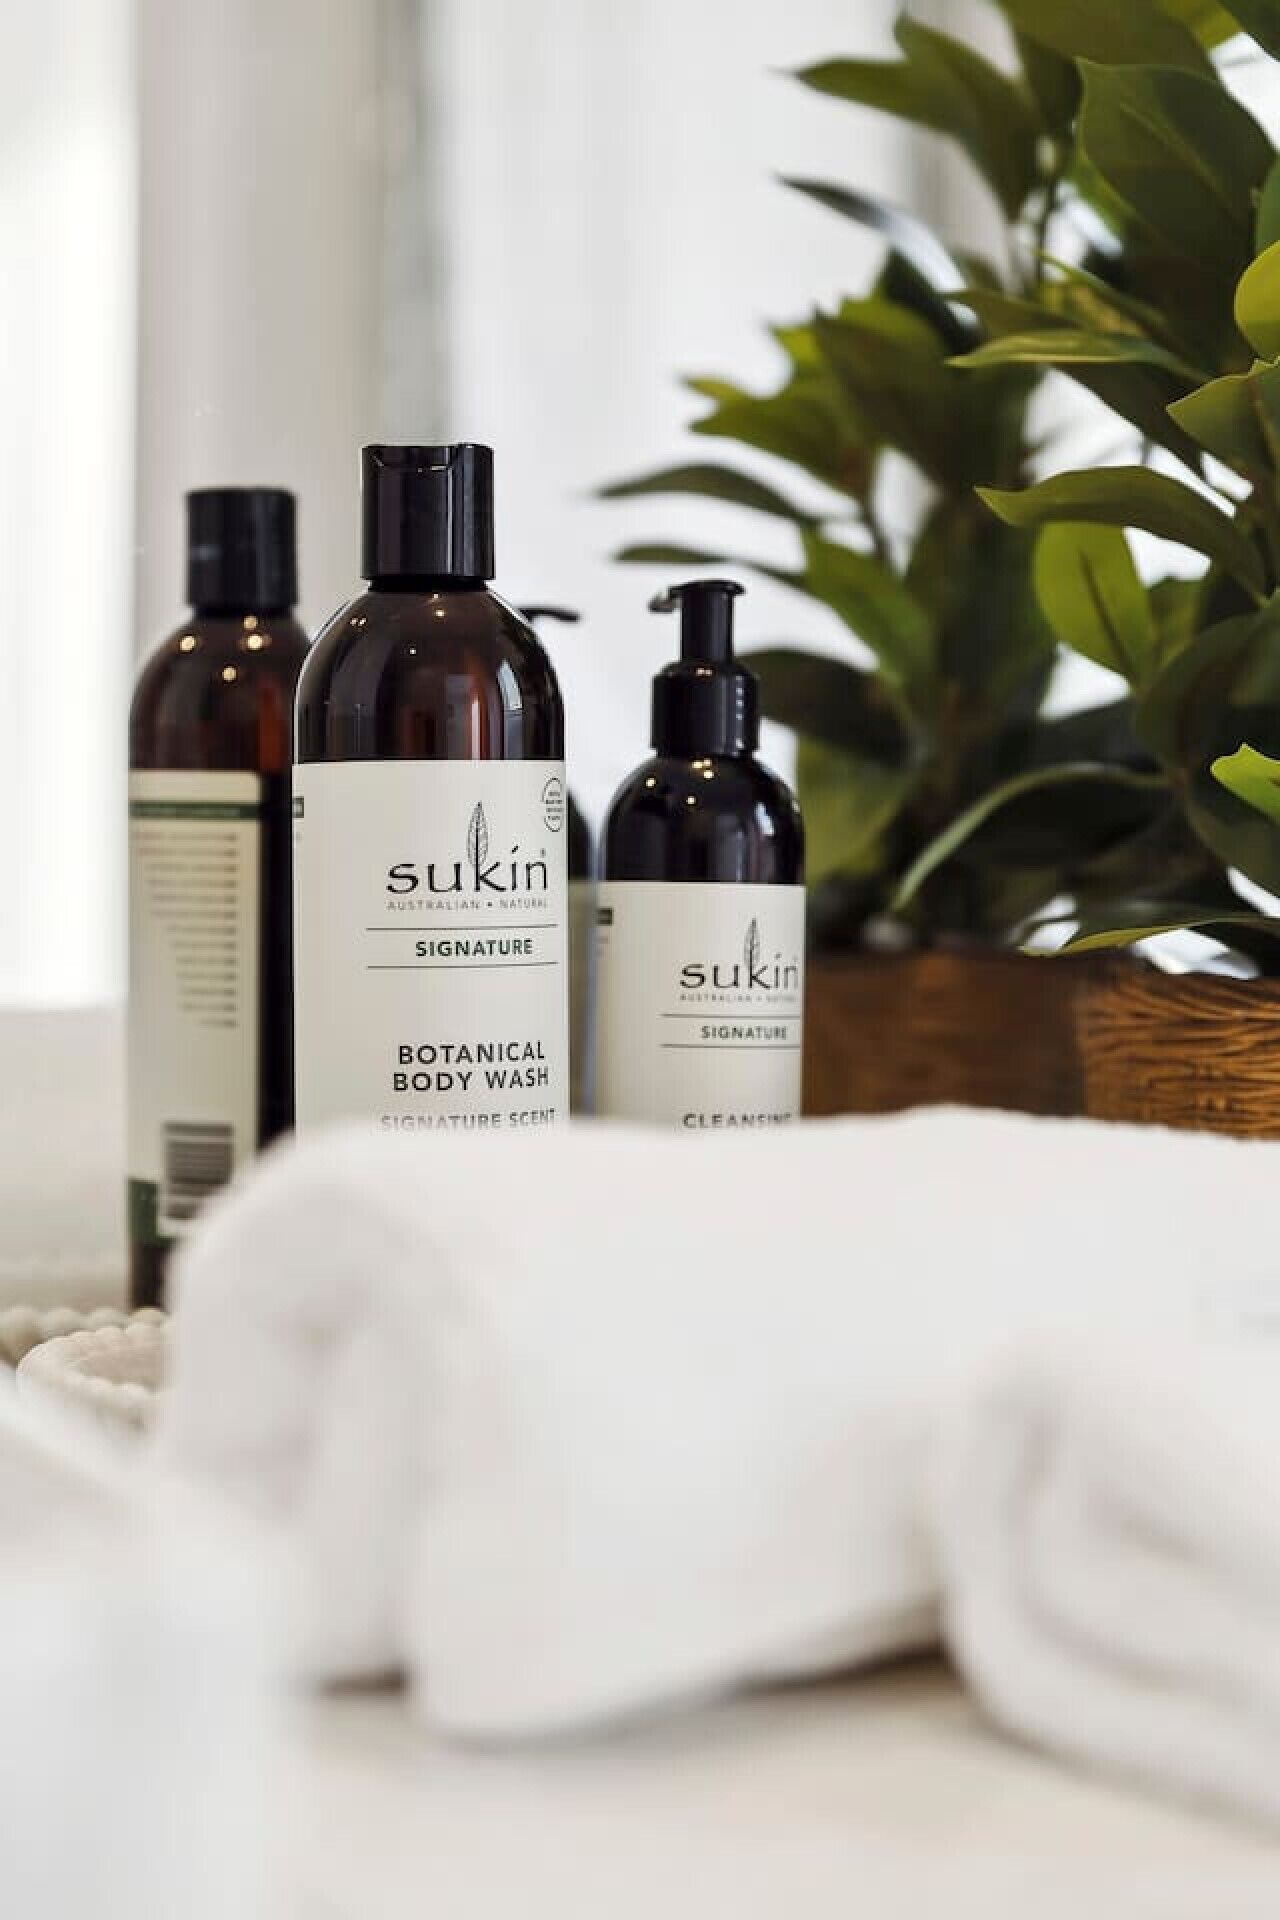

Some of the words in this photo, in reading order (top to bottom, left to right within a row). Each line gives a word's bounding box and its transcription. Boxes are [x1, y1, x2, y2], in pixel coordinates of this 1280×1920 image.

[387, 900, 480, 911] AUSTRALIAN
[415, 938, 533, 957] SIGNATURE
[701, 1026, 788, 1041] SIGNATURE
[399, 1040, 545, 1065] BOTANICAL
[393, 1071, 473, 1091] BODY
[485, 1067, 549, 1089] WASH
[381, 1113, 502, 1131] SIGNATURE
[509, 1107, 555, 1128] SCENT
